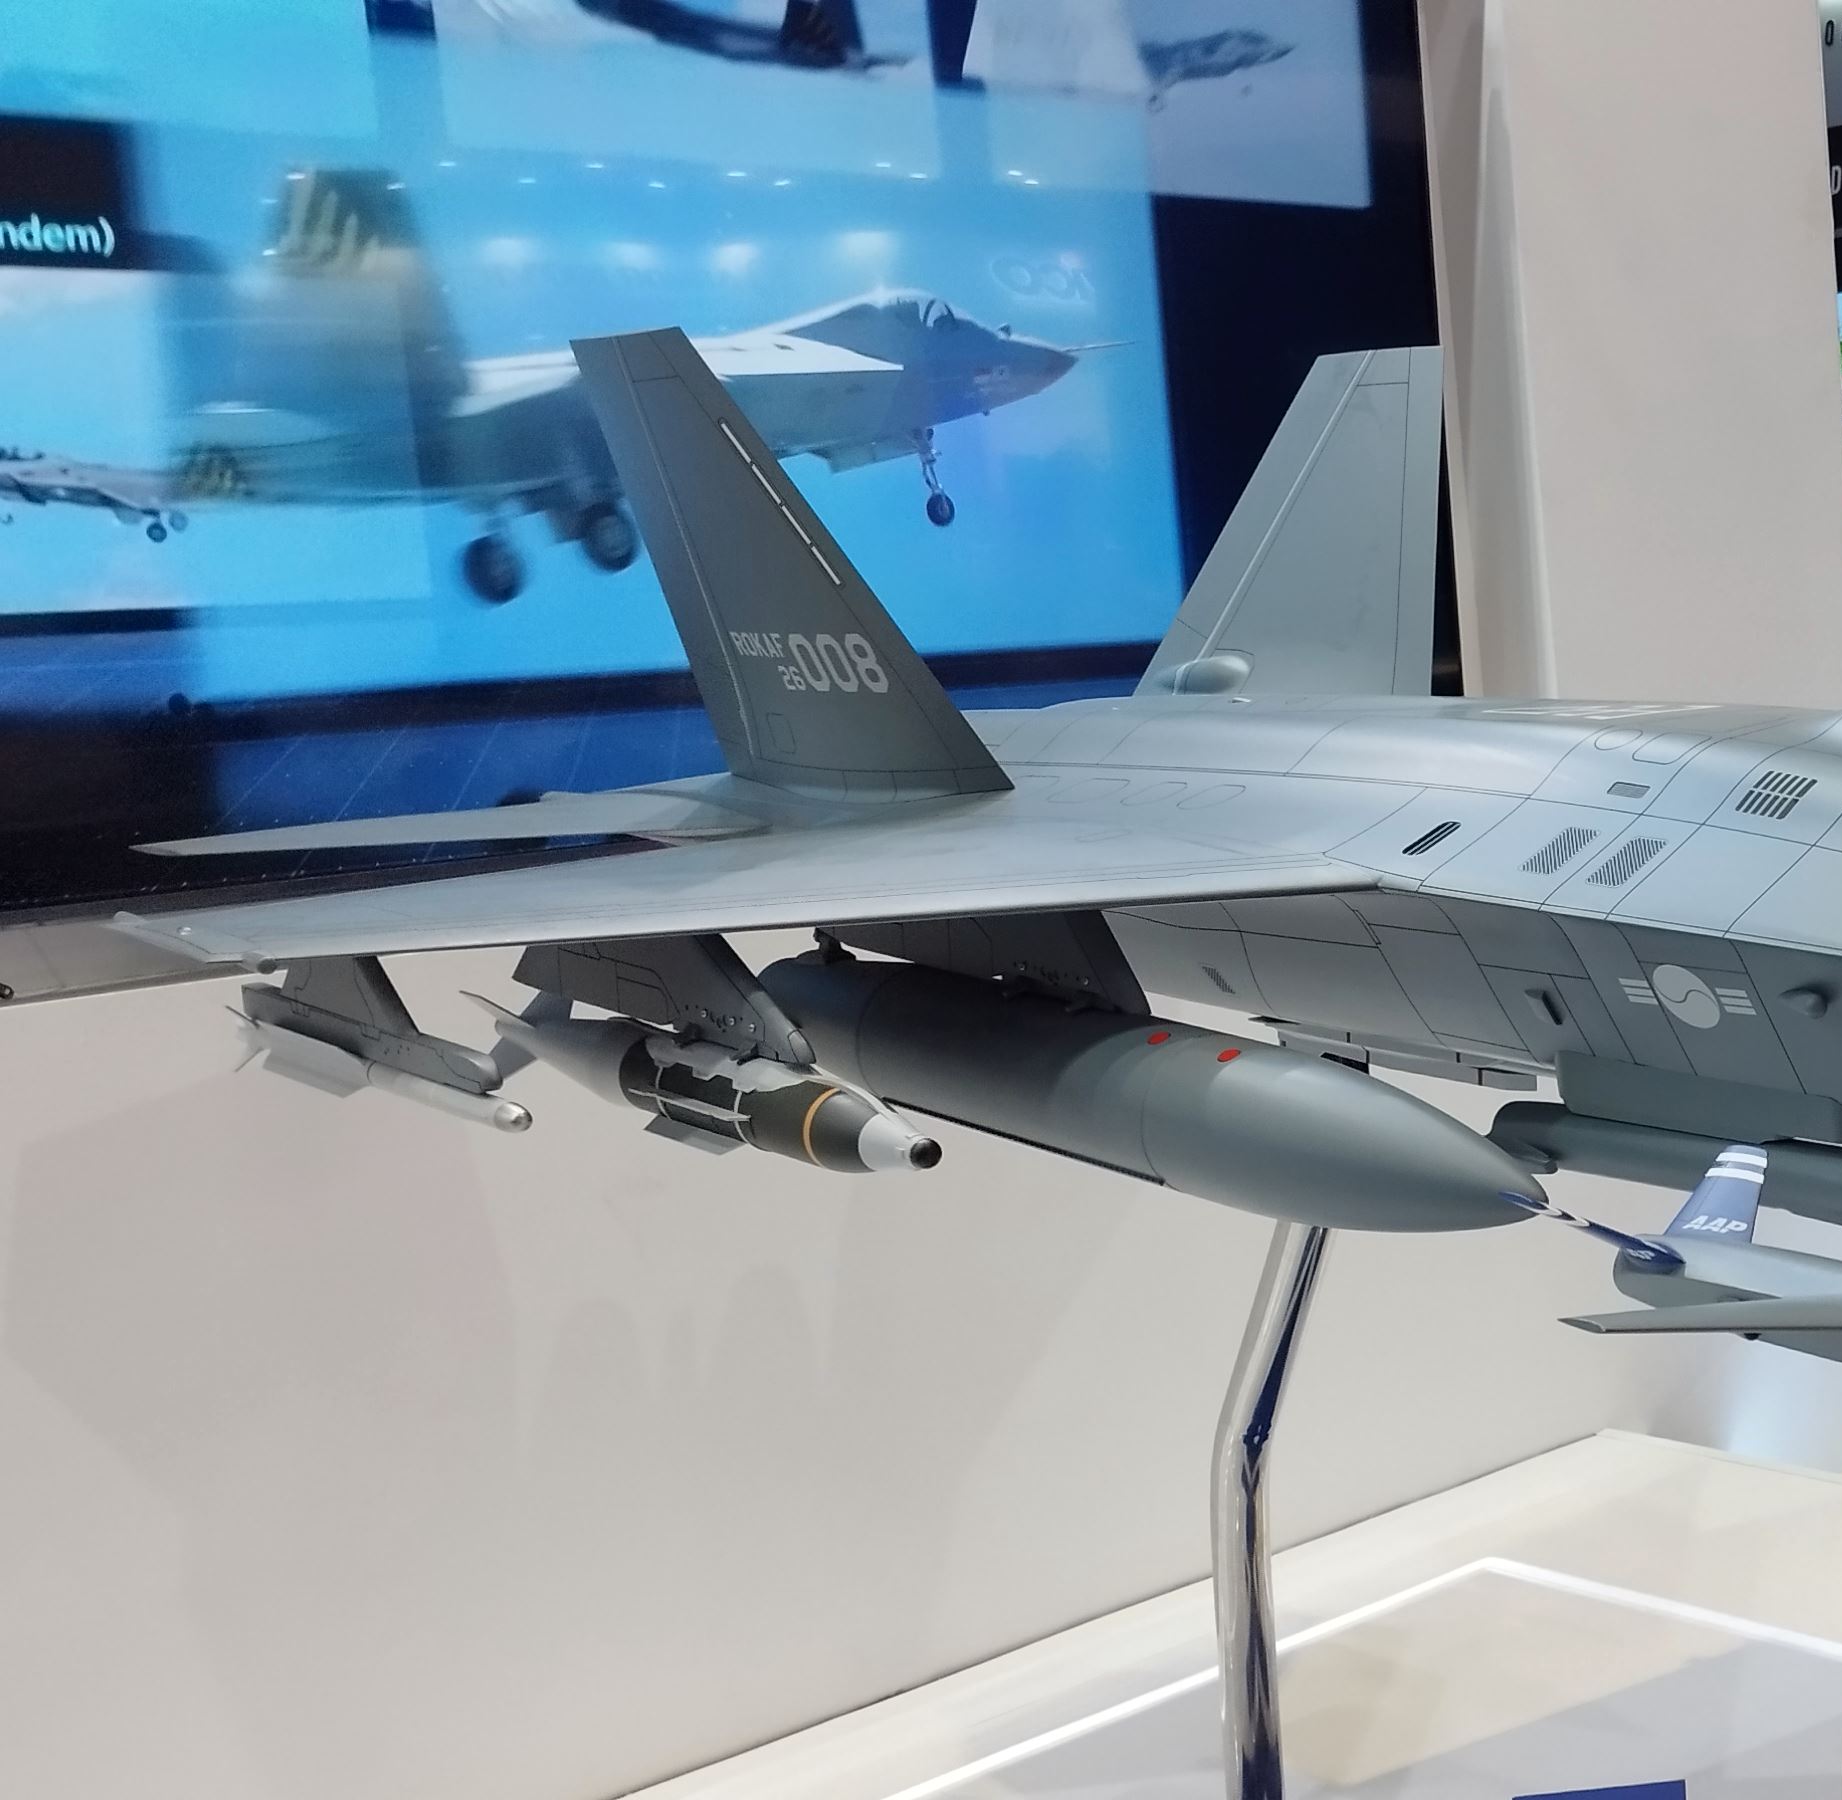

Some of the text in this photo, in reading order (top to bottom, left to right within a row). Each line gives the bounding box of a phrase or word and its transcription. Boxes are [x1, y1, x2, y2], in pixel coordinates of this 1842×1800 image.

[0, 211, 115, 258] ndem)
[729, 631, 786, 658] ROKAF
[777, 633, 889, 693] 26 008
[1682, 1214, 1748, 1233] AAP
